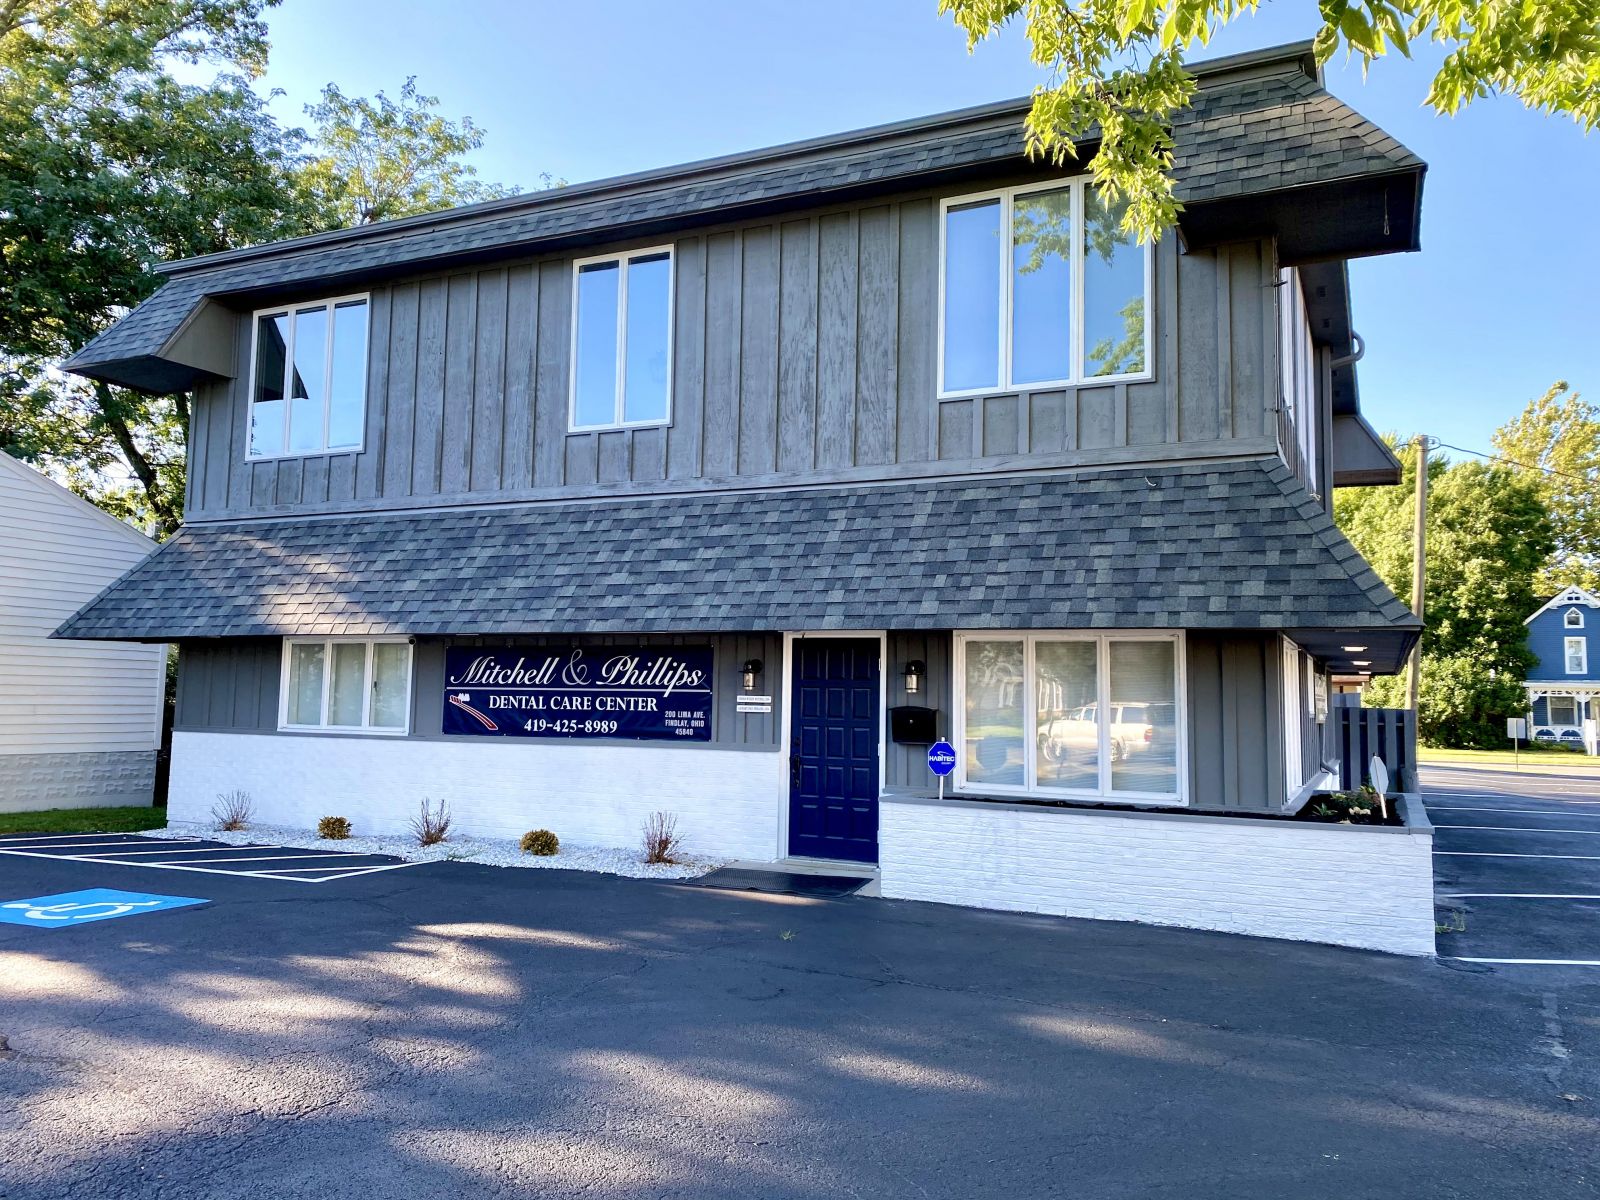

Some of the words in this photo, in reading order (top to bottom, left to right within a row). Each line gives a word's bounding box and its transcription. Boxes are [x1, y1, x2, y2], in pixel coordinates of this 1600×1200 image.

[450, 656, 560, 685] Mitchell
[561, 649, 592, 686] &
[595, 655, 707, 698] Phillips
[488, 695, 547, 709] DENTAL
[550, 696, 592, 711] CARE
[595, 696, 659, 712] CENTER
[664, 710, 676, 718] 200
[677, 710, 692, 719] LIMA
[693, 711, 706, 719] AVE.
[523, 718, 618, 734] 419-425-8989
[664, 719, 690, 728] FINDLAY,
[690, 720, 705, 728] OHIO
[675, 728, 694, 736] 45840
